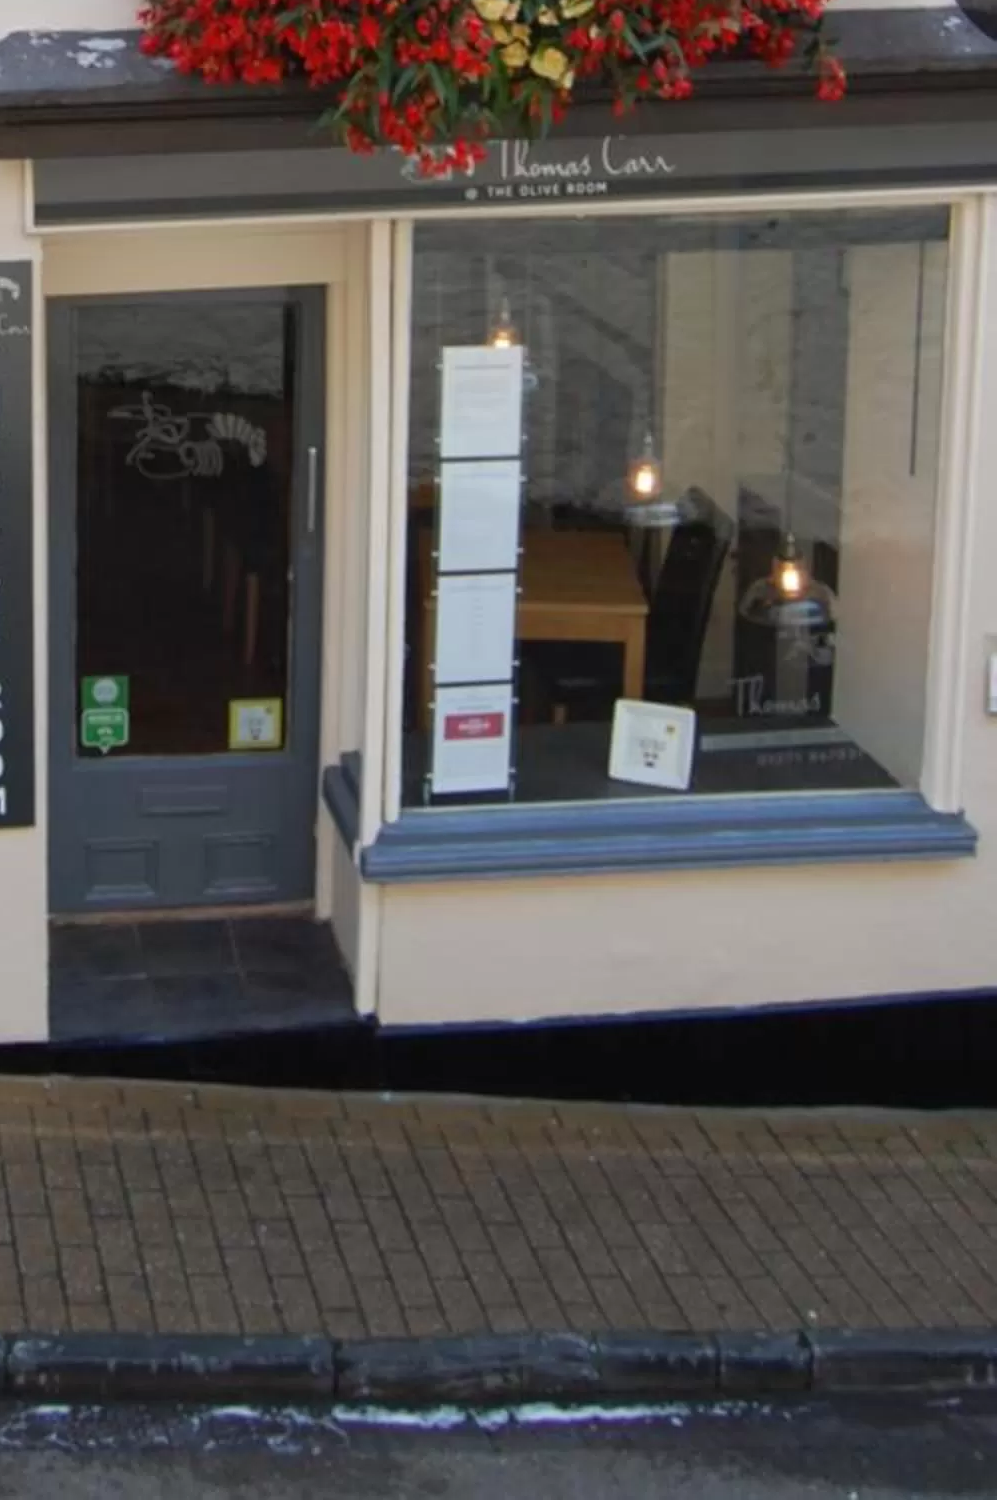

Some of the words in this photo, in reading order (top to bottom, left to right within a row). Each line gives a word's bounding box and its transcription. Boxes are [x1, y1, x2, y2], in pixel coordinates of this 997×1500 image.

[487, 138, 592, 180] Thomas
[602, 134, 676, 175] Carr
[487, 185, 512, 198] THE
[519, 183, 560, 196] OLIVE
[566, 181, 608, 194] ROOM
